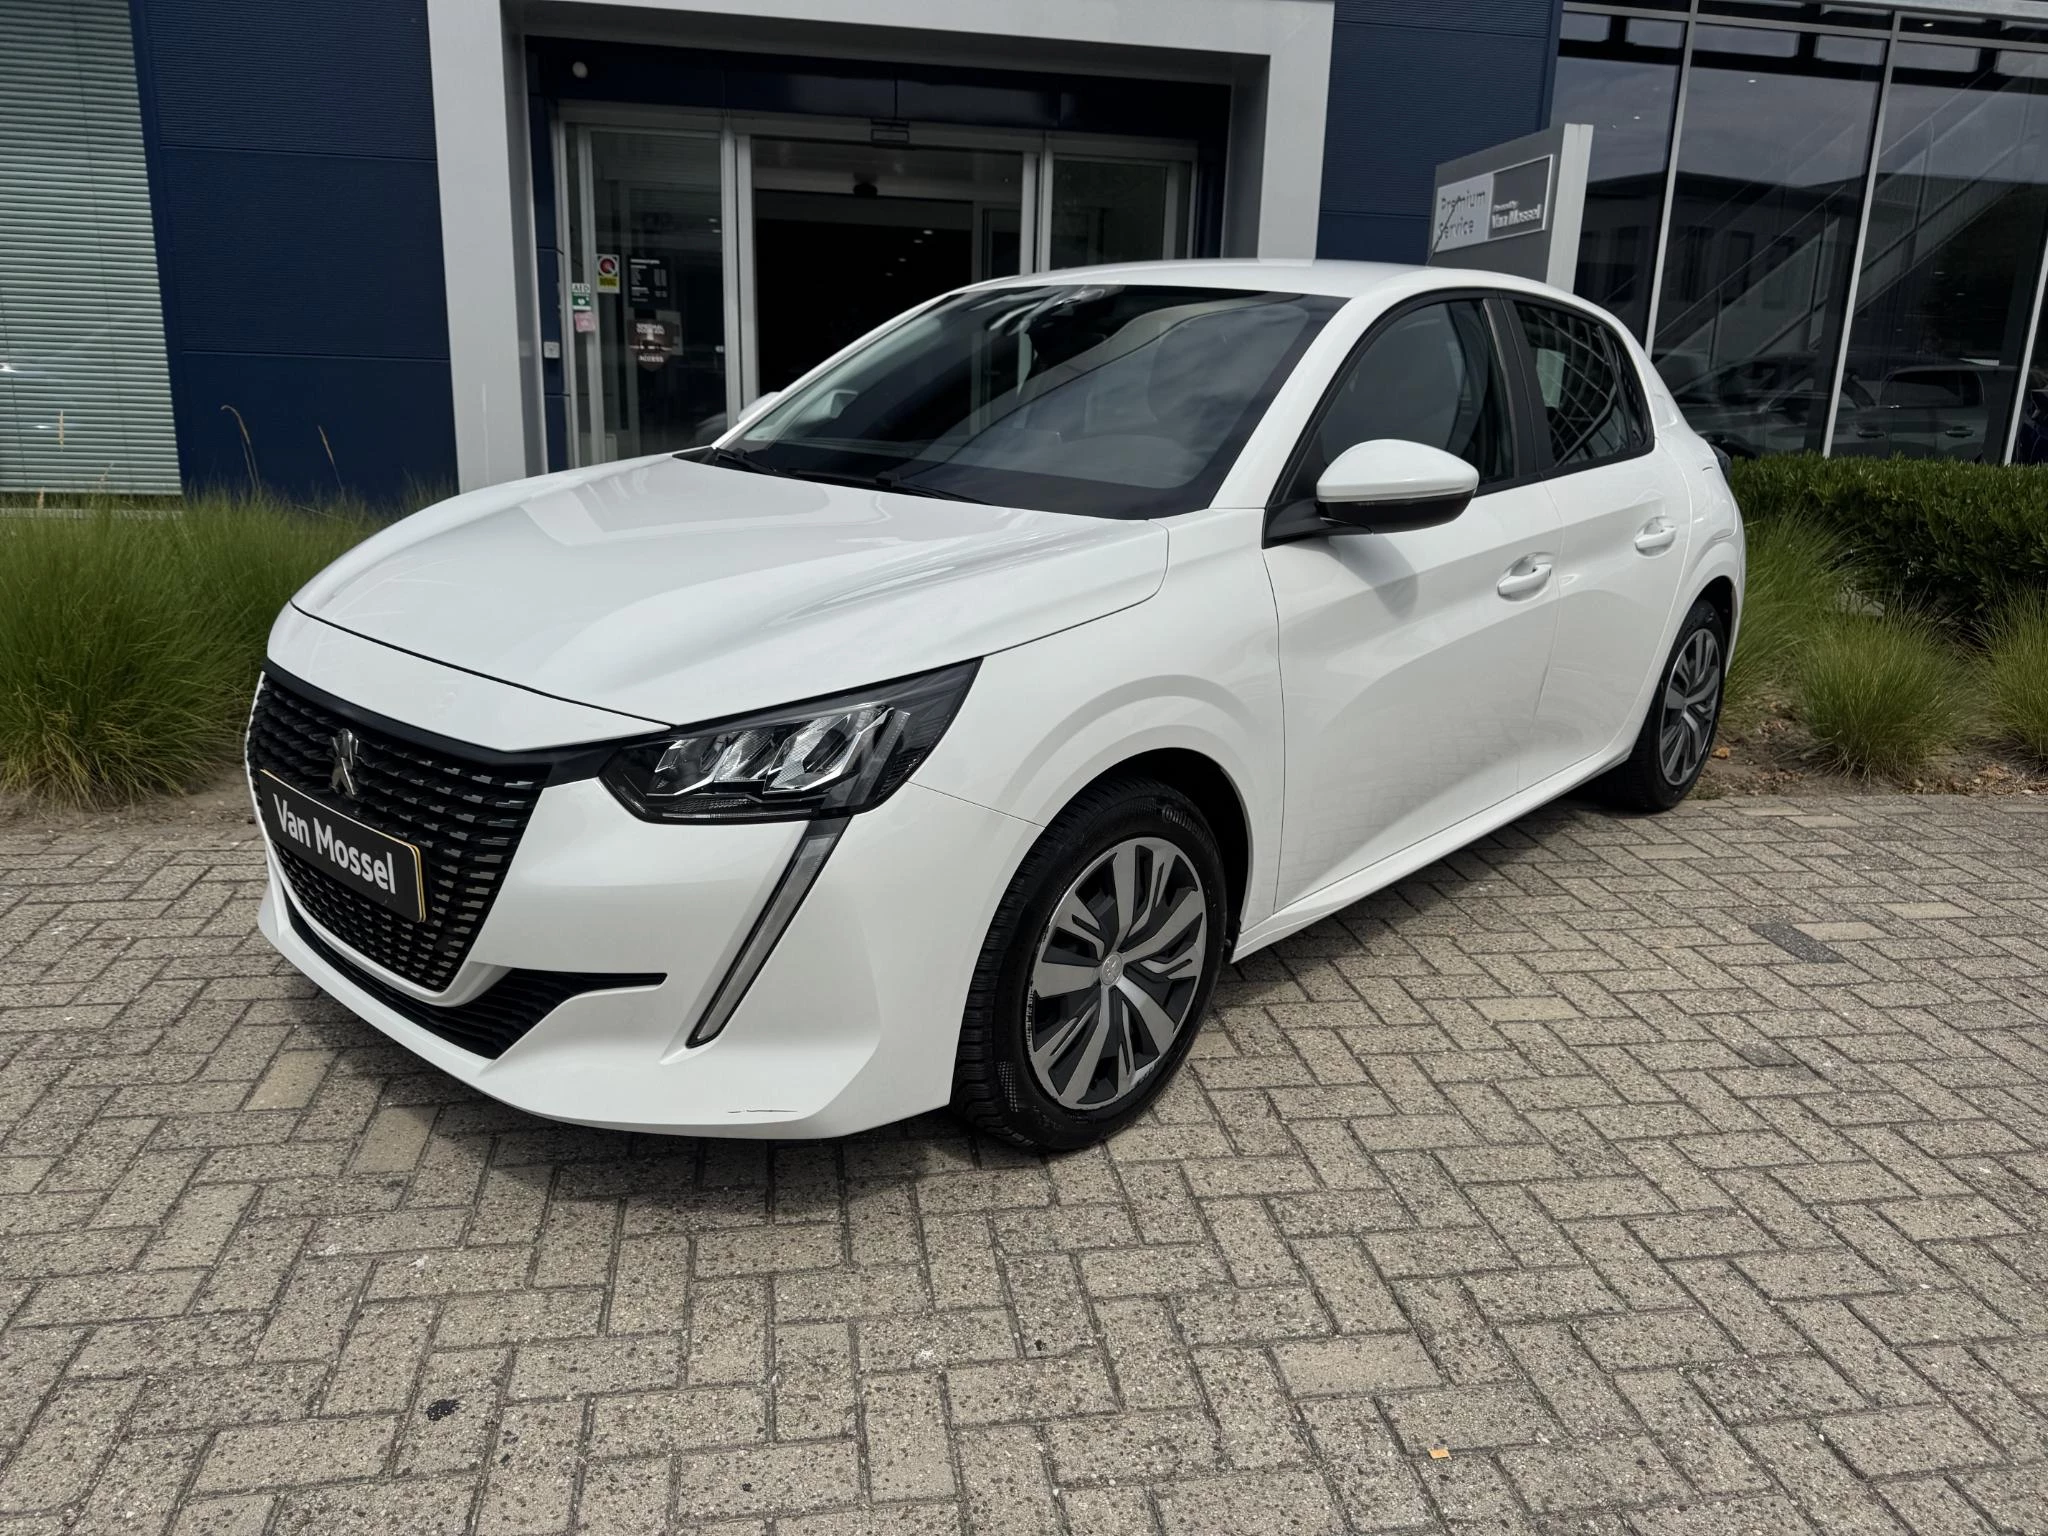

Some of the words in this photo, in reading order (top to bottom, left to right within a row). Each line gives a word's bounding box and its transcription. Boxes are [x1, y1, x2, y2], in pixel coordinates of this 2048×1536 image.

[1441, 189, 1486, 211] Premium
[1439, 215, 1474, 240] Service
[1492, 212, 1508, 229] Van
[1508, 204, 1542, 225] Mossel
[273, 793, 311, 848] Van
[313, 817, 396, 895] Mossel
